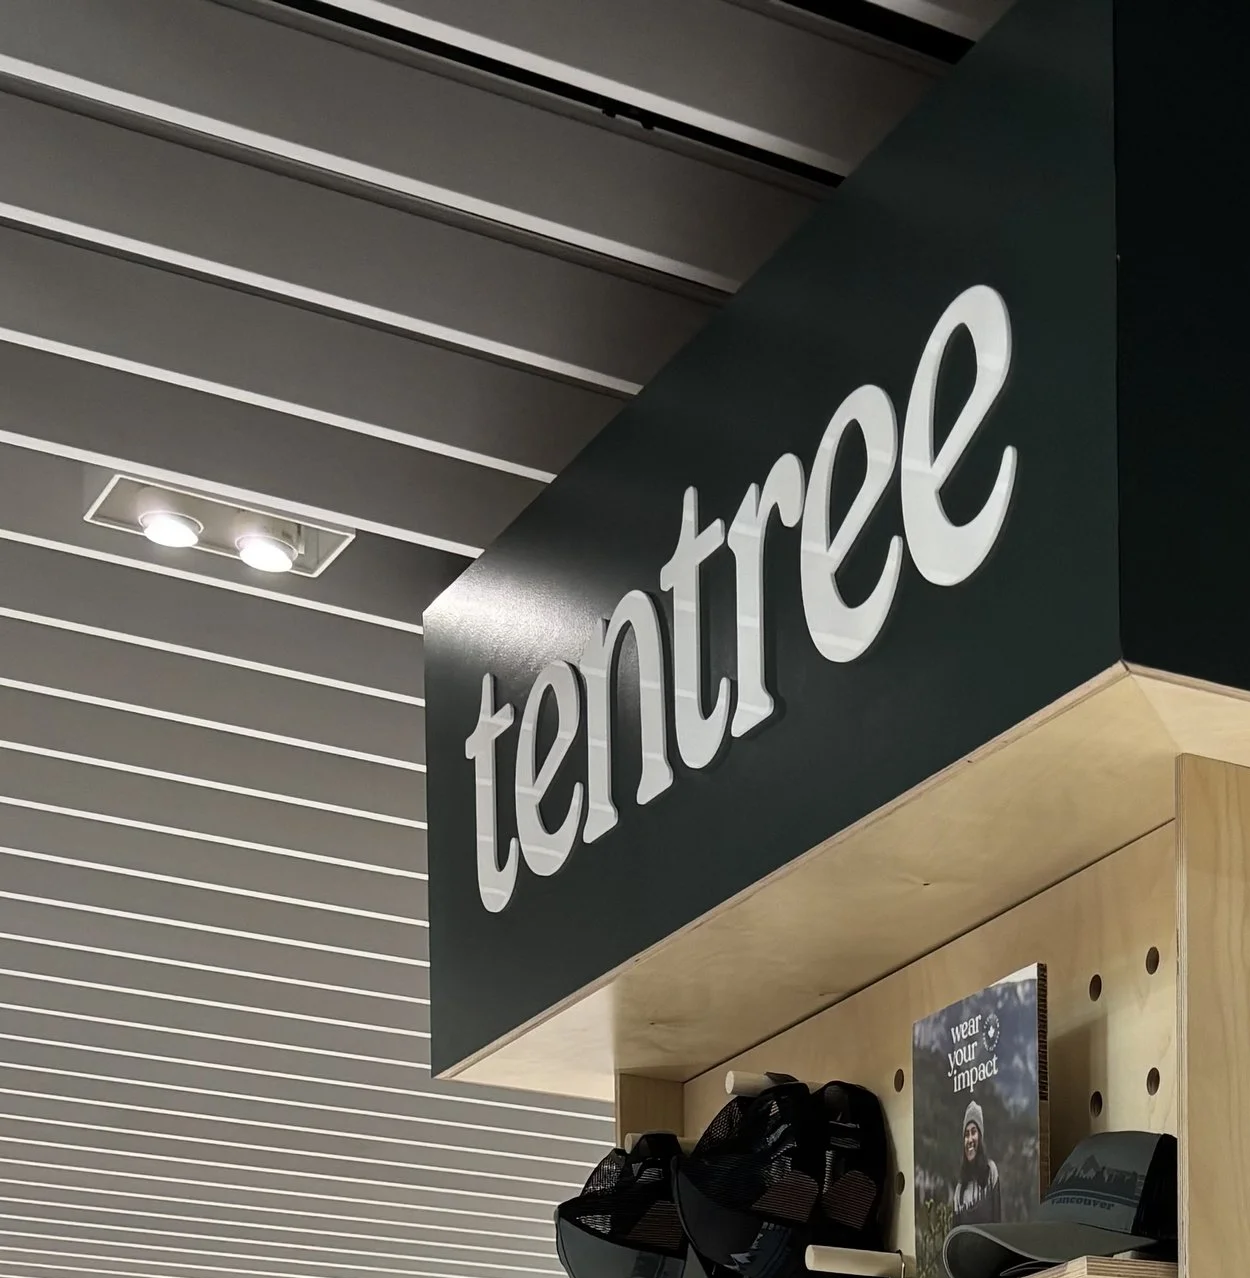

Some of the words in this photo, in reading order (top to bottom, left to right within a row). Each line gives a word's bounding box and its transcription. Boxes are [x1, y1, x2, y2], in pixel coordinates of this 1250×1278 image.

[465, 284, 1017, 913] tentree
[950, 1014, 982, 1044] wear
[947, 1041, 978, 1077] your
[953, 1054, 999, 1093] impact
